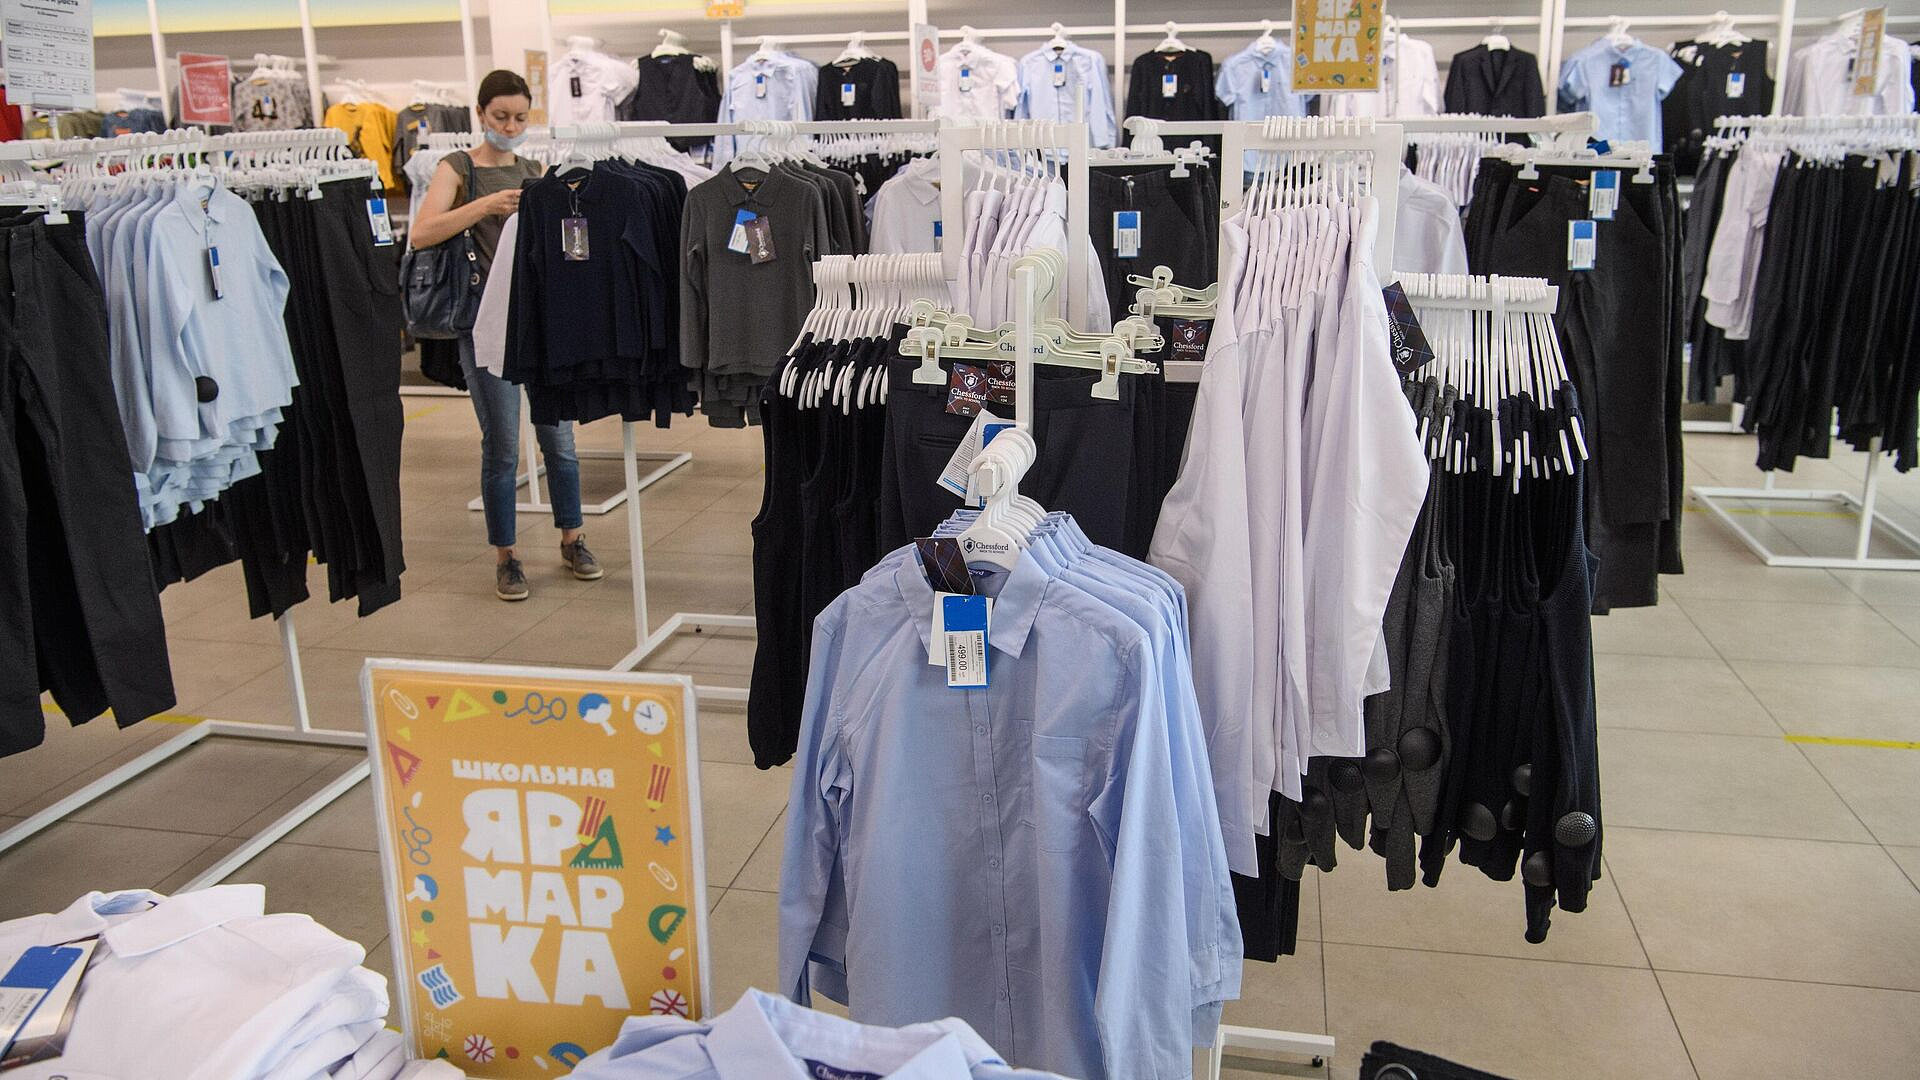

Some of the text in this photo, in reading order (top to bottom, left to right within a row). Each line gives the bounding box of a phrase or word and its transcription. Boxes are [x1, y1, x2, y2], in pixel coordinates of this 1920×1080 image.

[1316, 0, 1350, 18] ЯР
[1314, 20, 1360, 37] МАР
[1313, 37, 1359, 62] КА
[1173, 342, 1204, 350] Chessford
[988, 377, 1015, 387] Chessfo
[951, 387, 987, 400] Chessford
[976, 542, 1009, 550] Chessford
[958, 645, 967, 670] 499.00
[452, 759, 615, 788] ШКОЛЬНАЯ
[461, 788, 582, 867] ЯР
[464, 866, 624, 928] МАР
[470, 922, 631, 1009] КА
